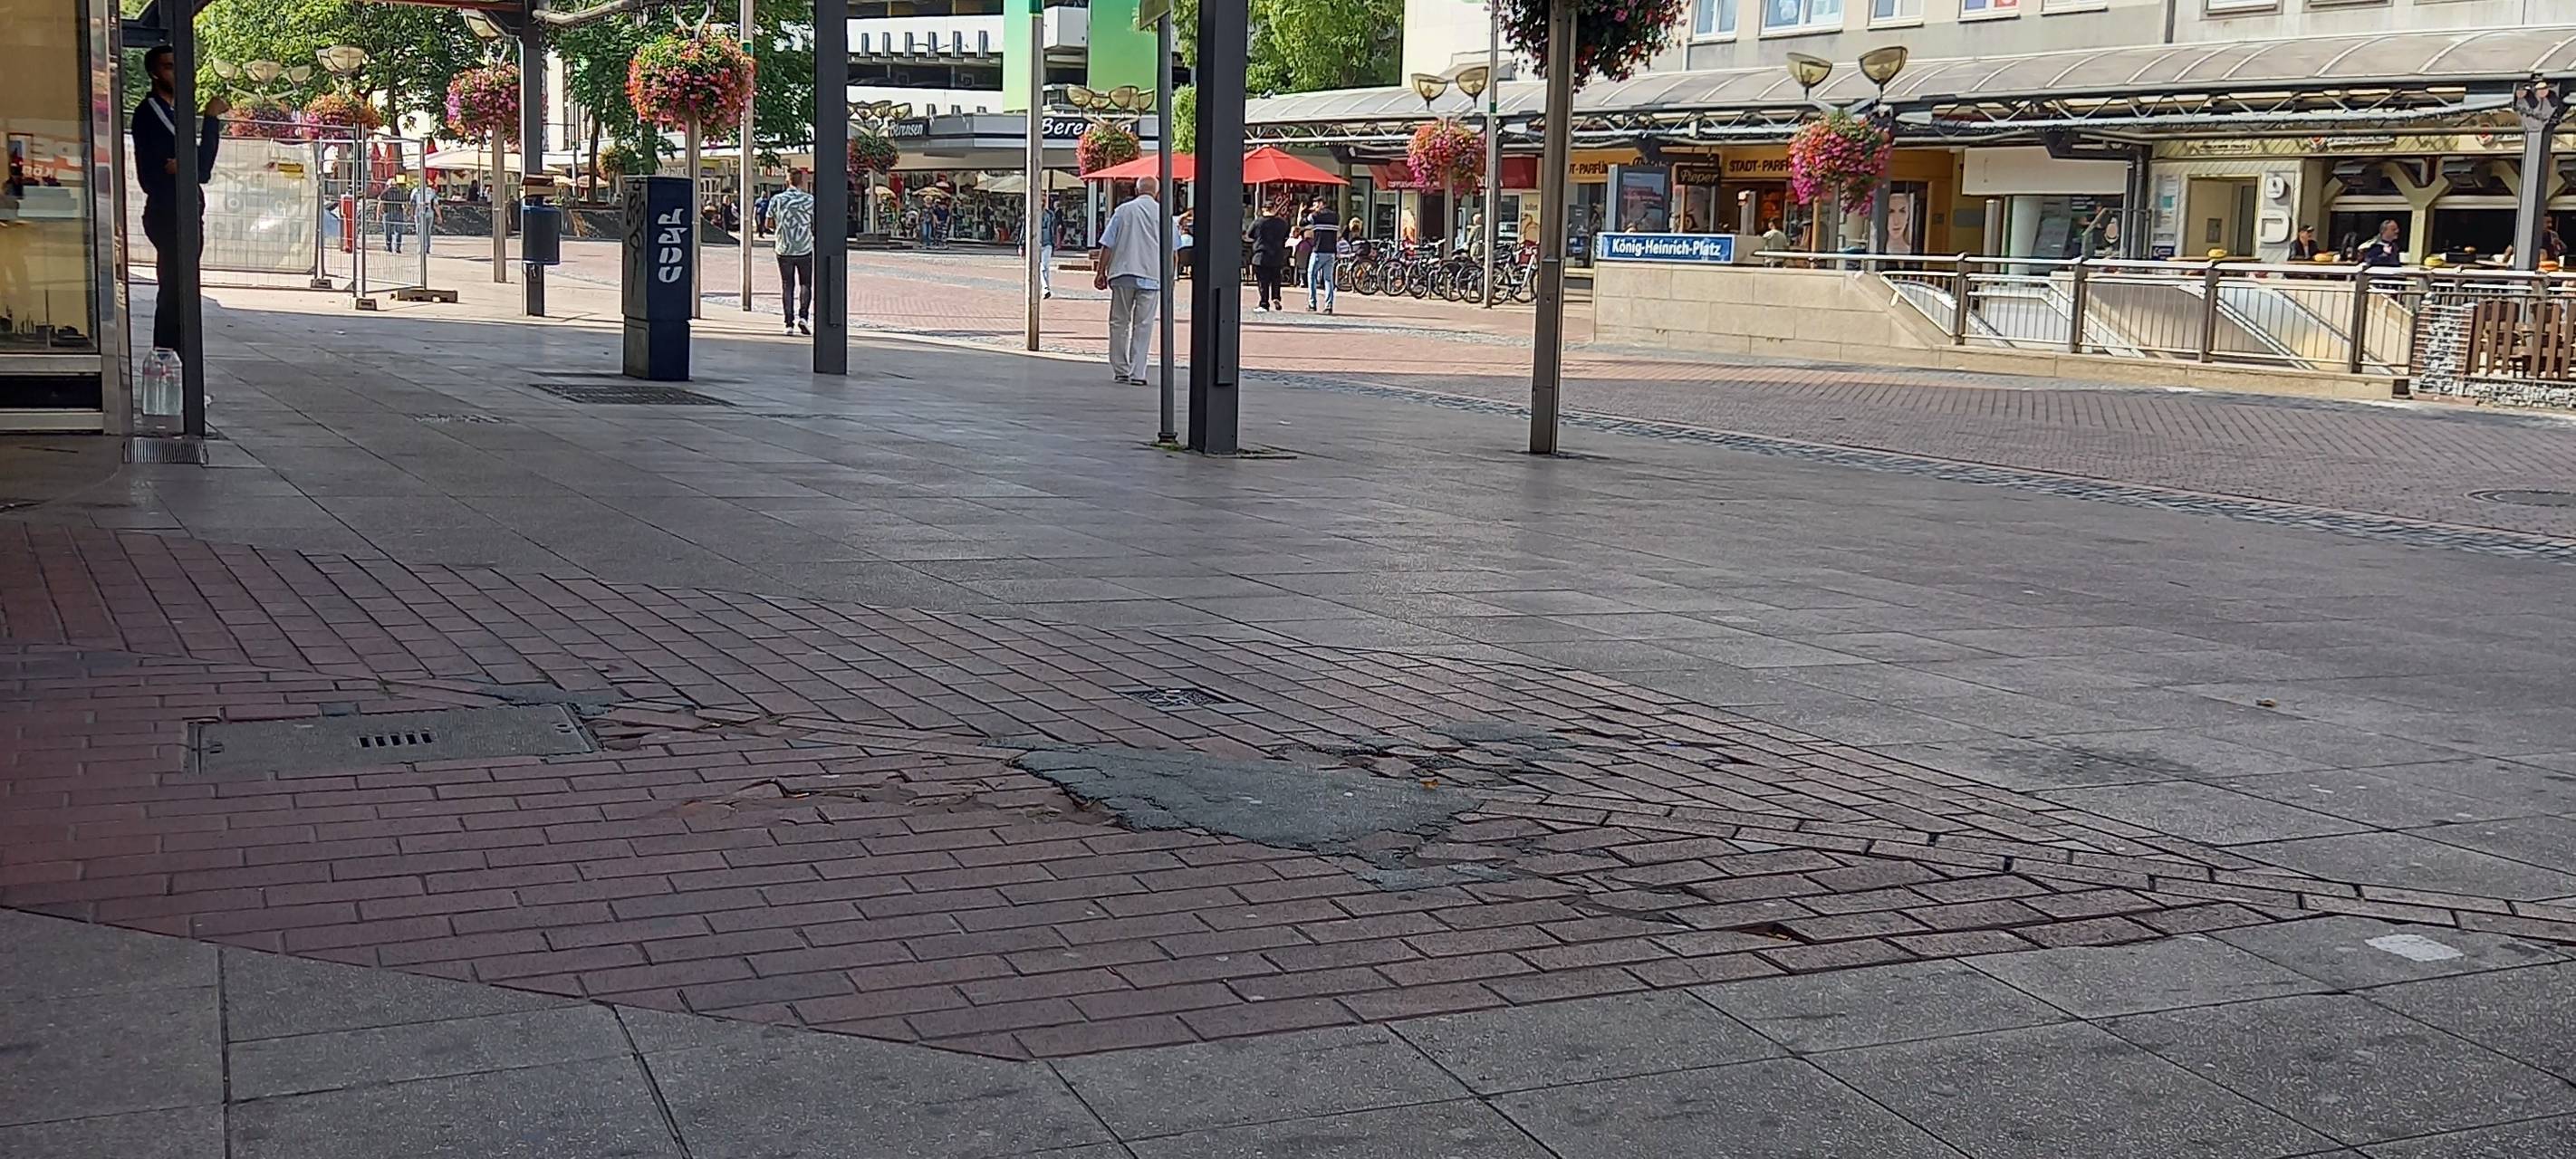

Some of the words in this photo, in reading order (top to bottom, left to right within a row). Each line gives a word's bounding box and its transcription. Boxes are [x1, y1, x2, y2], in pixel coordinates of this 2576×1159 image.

[889, 120, 924, 137] Berensen
[1042, 117, 1132, 136] Berenn
[1679, 168, 1719, 185] Pieper
[1611, 237, 1722, 257] König-Heinrich-Platz
